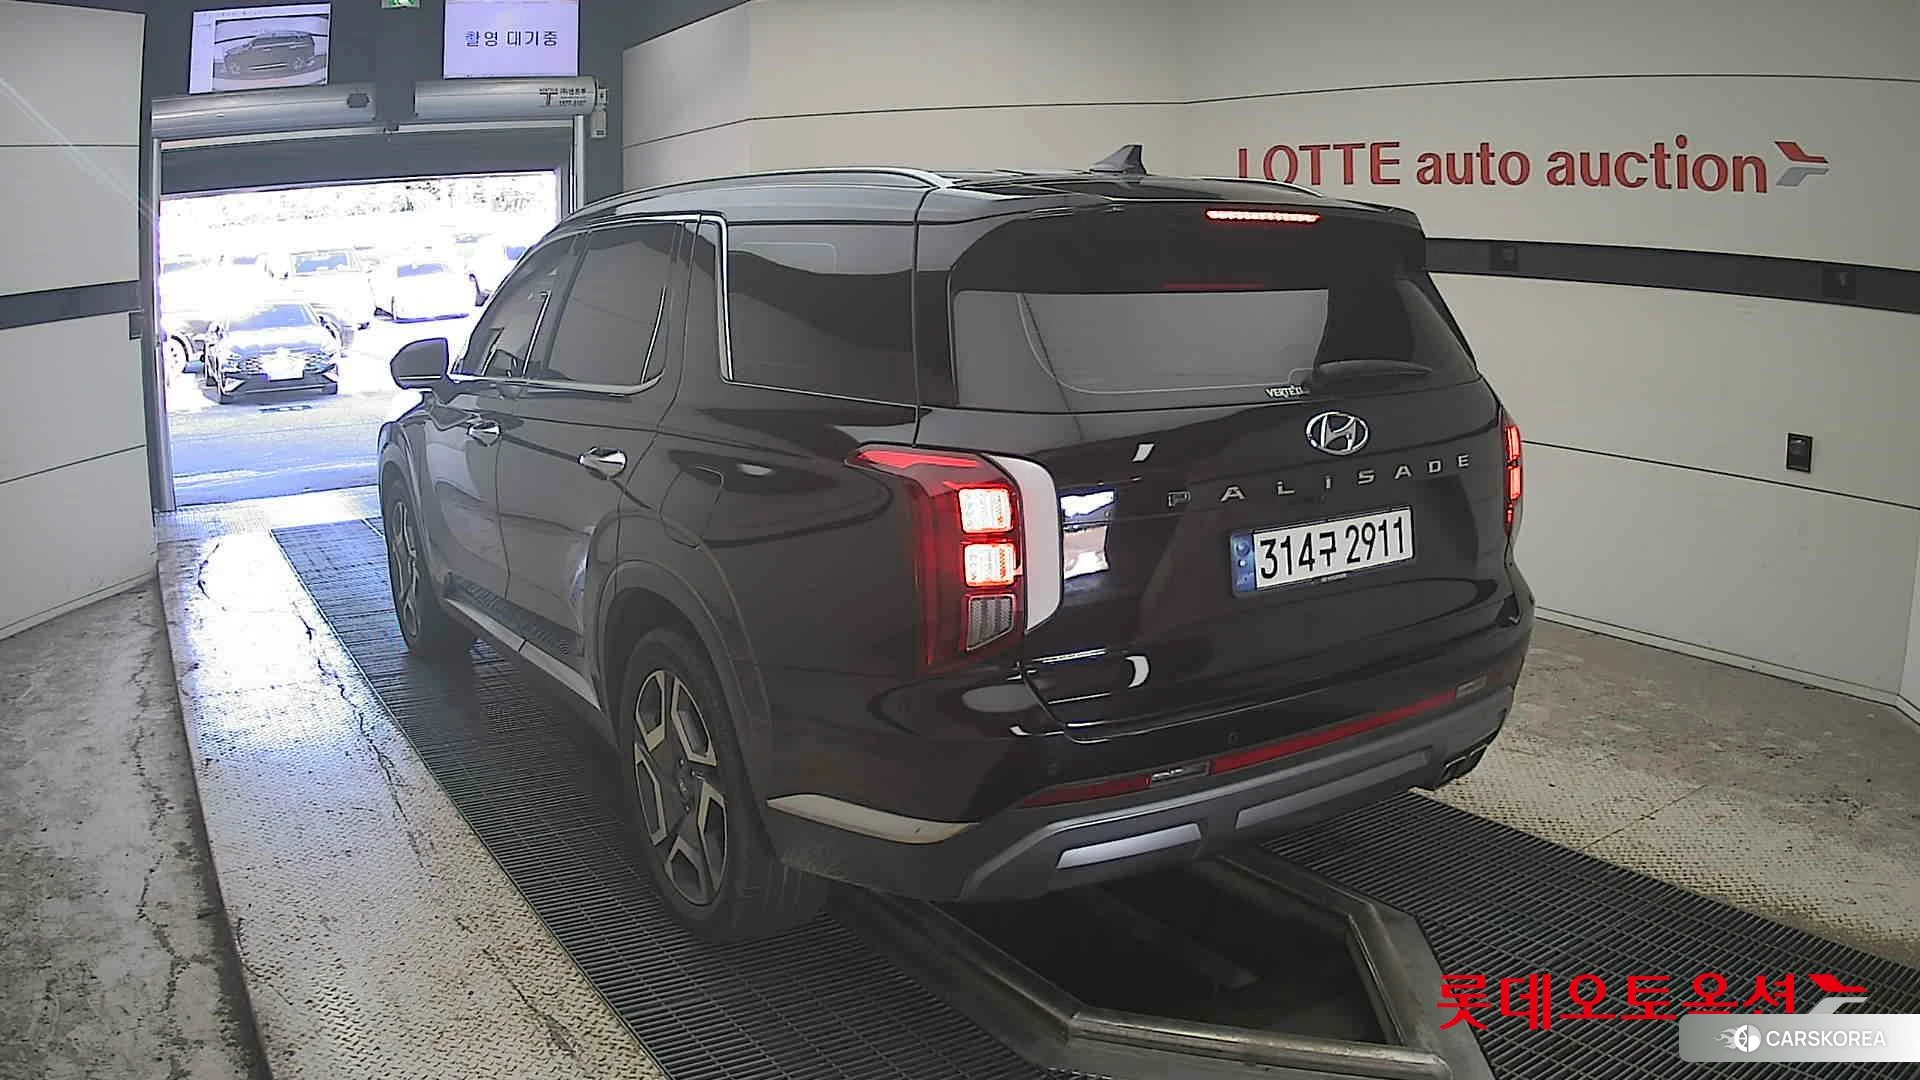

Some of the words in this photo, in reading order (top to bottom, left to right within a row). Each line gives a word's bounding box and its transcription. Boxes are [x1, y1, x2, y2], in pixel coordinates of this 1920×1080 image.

[506, 30, 558, 47] 대기중
[1238, 142, 1400, 185] LOTTE
[1415, 141, 1531, 186] auto
[1545, 134, 1768, 194] auction
[1167, 454, 1472, 507] PALISADE
[1260, 531, 1337, 579] 314구
[1345, 516, 1404, 565] 2911
